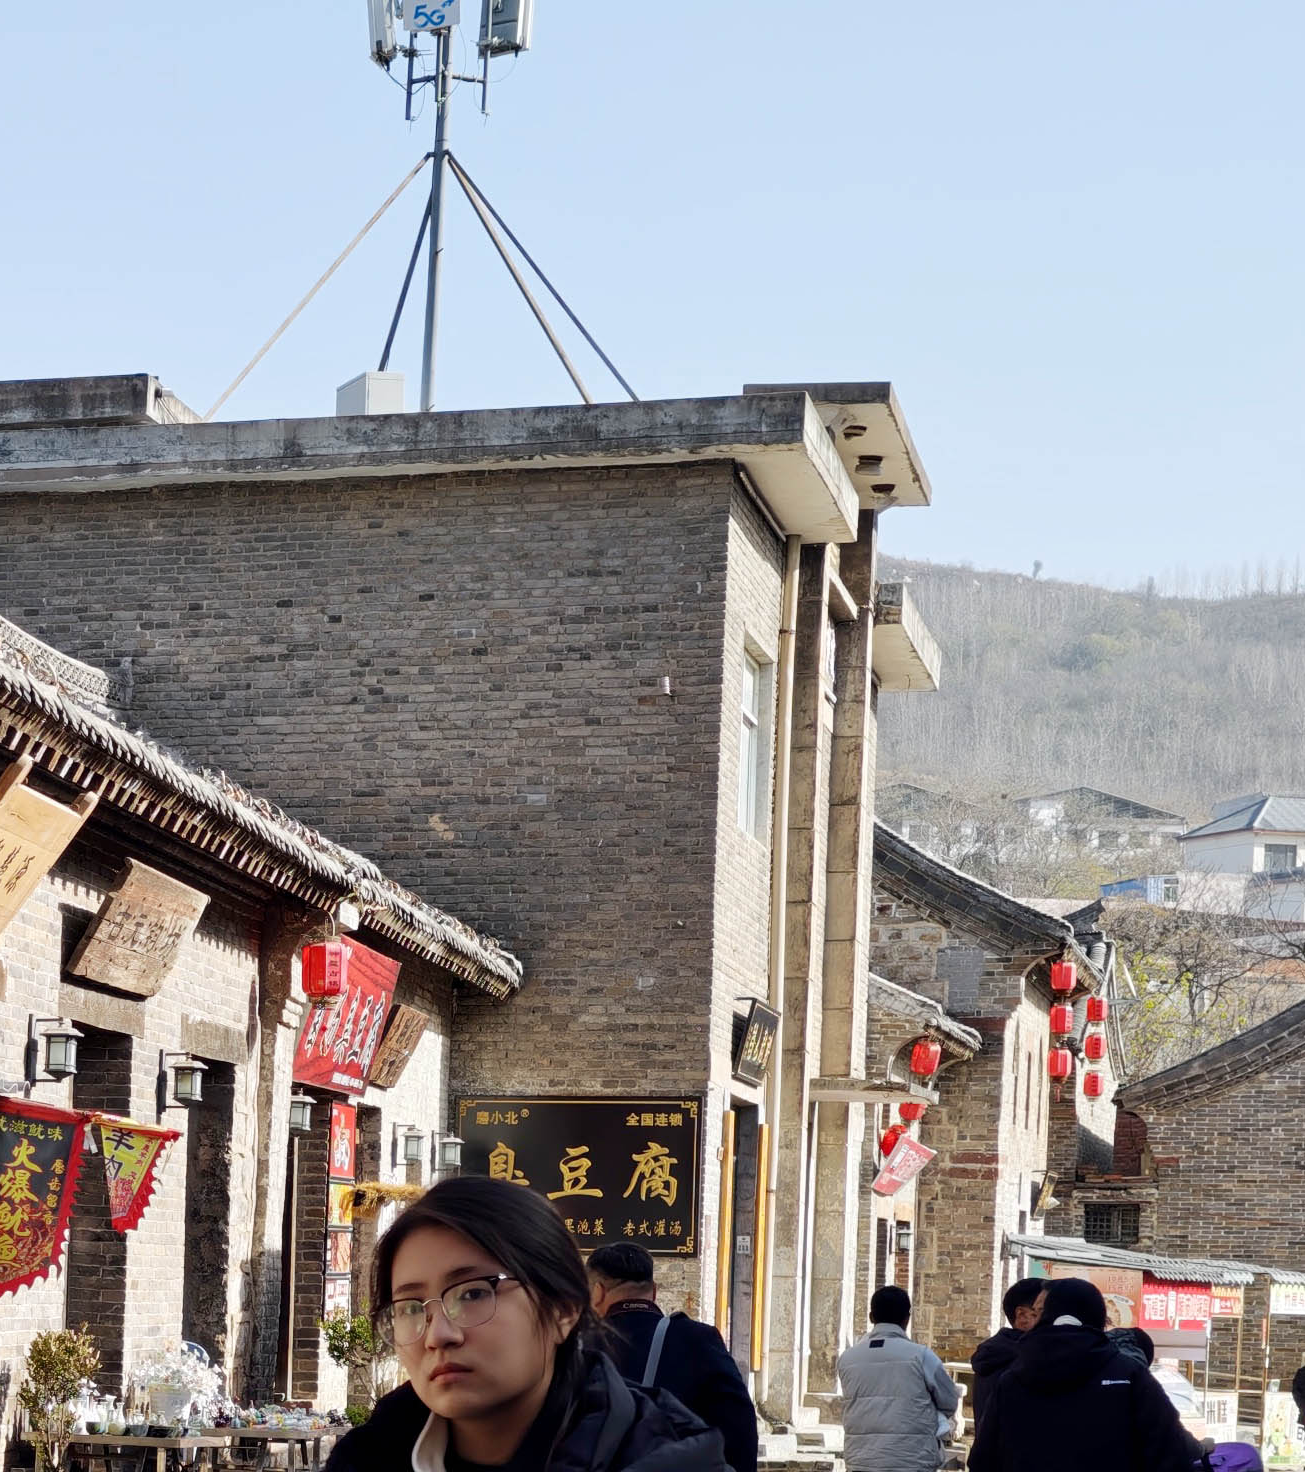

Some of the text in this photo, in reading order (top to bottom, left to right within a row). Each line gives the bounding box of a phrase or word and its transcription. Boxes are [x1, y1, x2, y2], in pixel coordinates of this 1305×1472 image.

[413, 4, 446, 28] 5G
[625, 1112, 684, 1128] 全国连锁
